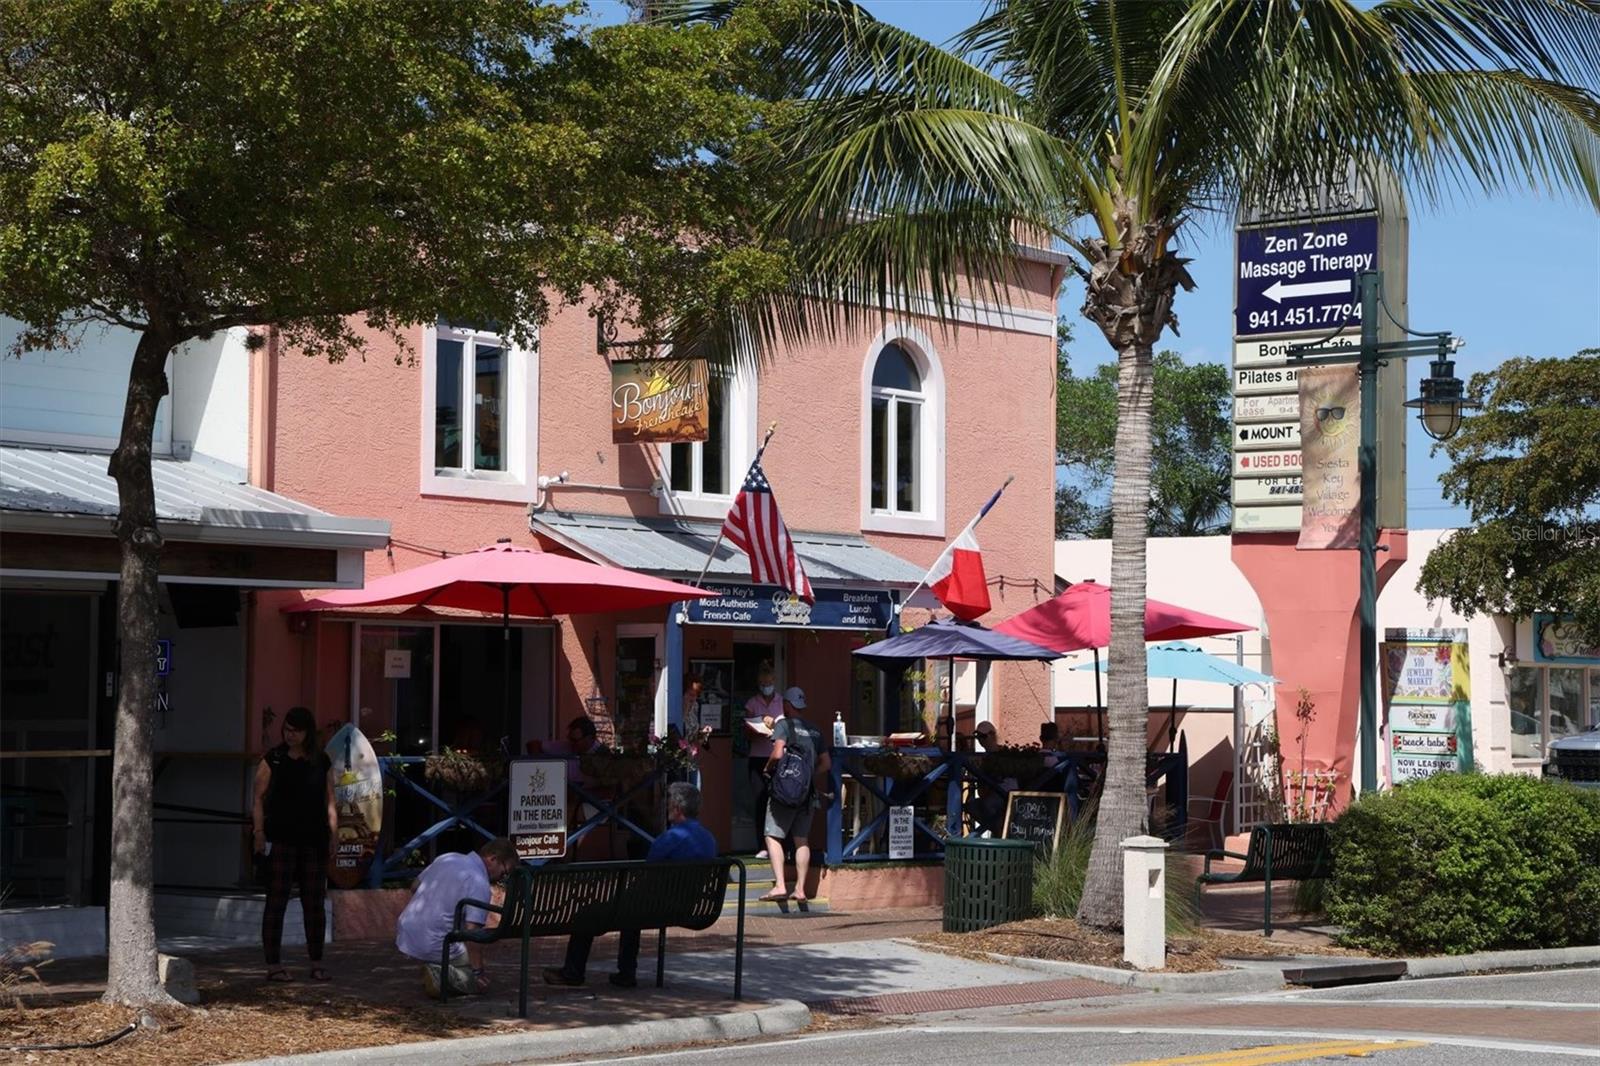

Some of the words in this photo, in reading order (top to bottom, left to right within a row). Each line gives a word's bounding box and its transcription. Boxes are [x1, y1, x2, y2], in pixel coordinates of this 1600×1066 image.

[1265, 236, 1297, 253] Zen
[1303, 232, 1348, 250] Zone
[1241, 261, 1306, 278] Massage
[1310, 253, 1373, 272] Therapy
[1249, 303, 1362, 328] 941.451.7794
[1239, 371, 1282, 384] Pilates
[1243, 397, 1259, 407] For
[1237, 407, 1265, 416] Lease
[1251, 427, 1293, 439] MOUNT
[1253, 456, 1280, 467] USED
[1317, 458, 1349, 469] Siesta
[1323, 473, 1344, 488] Key
[1317, 490, 1349, 504] Village
[733, 587, 754, 598] Key's
[843, 593, 878, 602] Breakfast
[699, 598, 719, 607] Most
[720, 599, 759, 609] Authentic
[849, 604, 872, 613] Lunch
[703, 610, 731, 620] French
[732, 611, 751, 620] Cafe
[842, 615, 856, 624] and
[858, 616, 877, 624] More
[1407, 669, 1433, 677] JEWELRY
[1407, 678, 1433, 686] MARKET
[1426, 737, 1446, 747] babe
[520, 795, 556, 807] PARKING
[513, 810, 522, 821] IN
[524, 810, 539, 821] THE
[541, 809, 562, 820] REAR
[891, 808, 913, 816] PARKING
[900, 817, 910, 825] THE
[516, 835, 542, 846] Bonjour
[543, 835, 559, 845] Cafe
[336, 859, 356, 867] LUNCH
